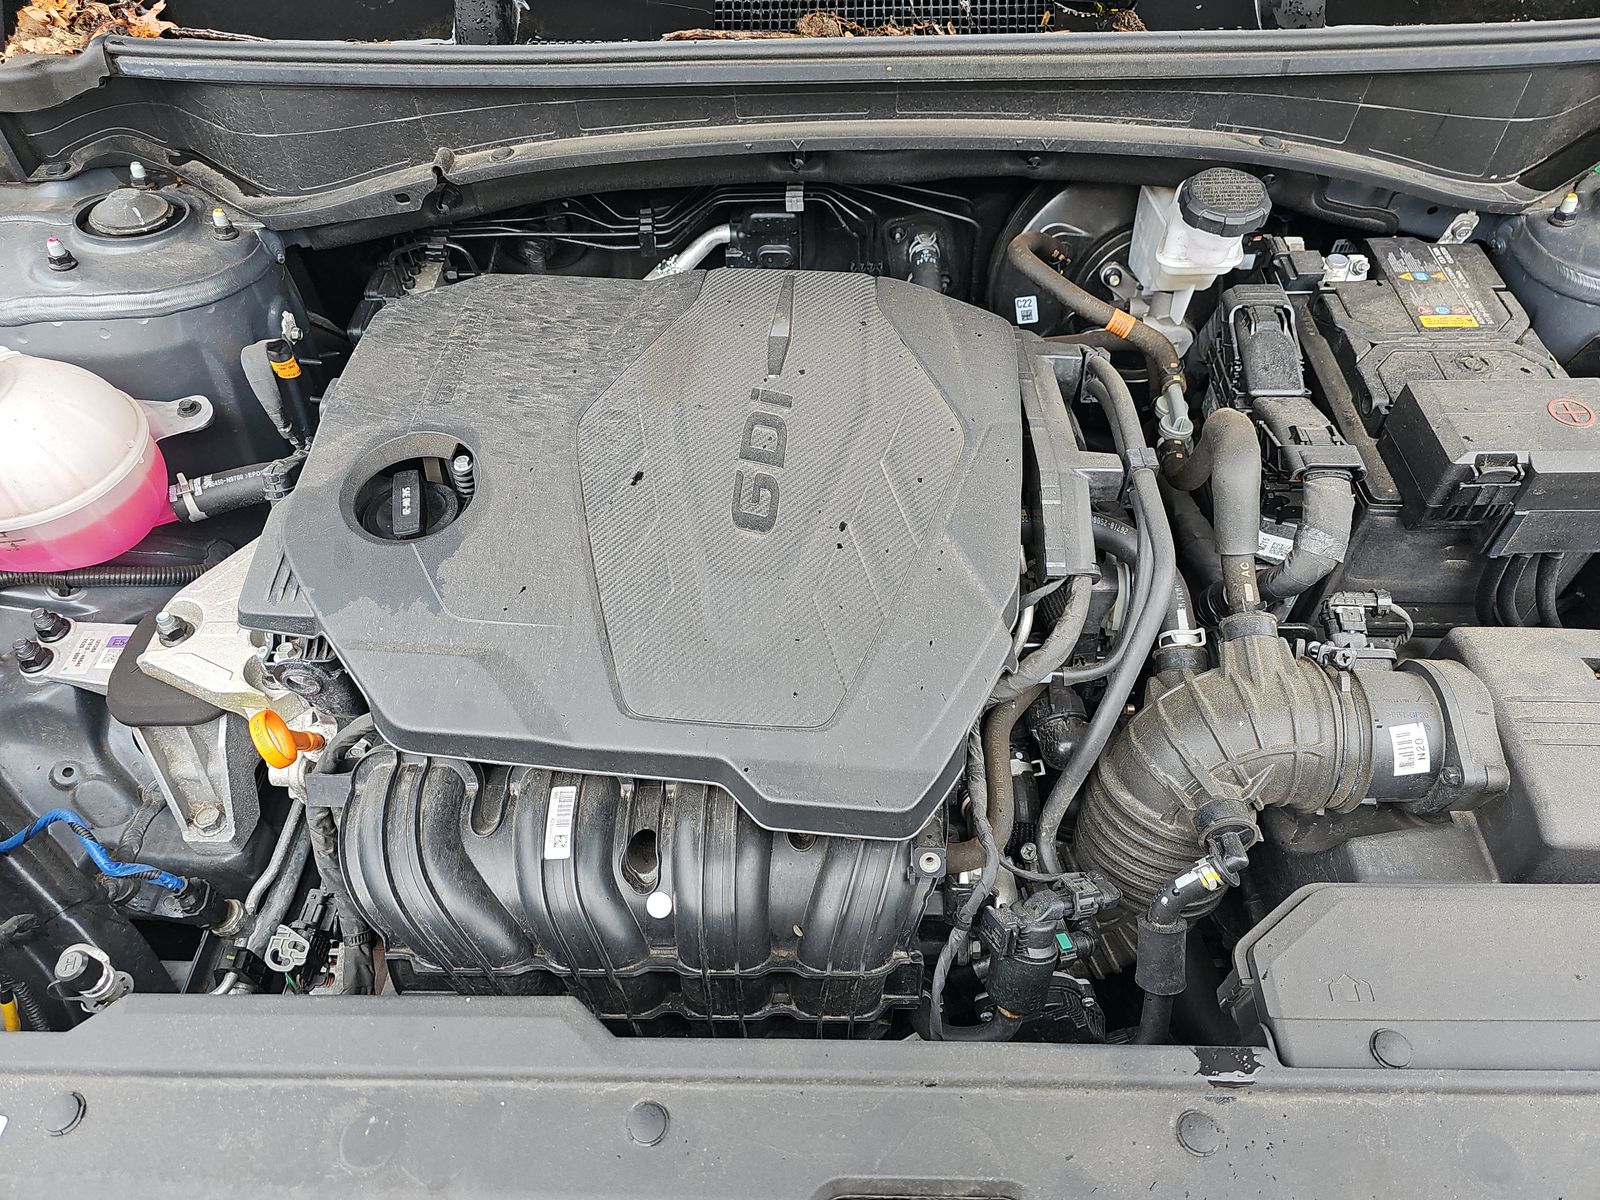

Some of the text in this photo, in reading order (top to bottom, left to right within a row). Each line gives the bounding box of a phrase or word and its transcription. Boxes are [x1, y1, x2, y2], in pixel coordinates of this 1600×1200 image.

[1016, 298, 1033, 309] C22
[402, 486, 411, 498] SAE
[1241, 562, 1252, 579] AC
[1414, 738, 1427, 761] N20
[64, 956, 77, 972] H
